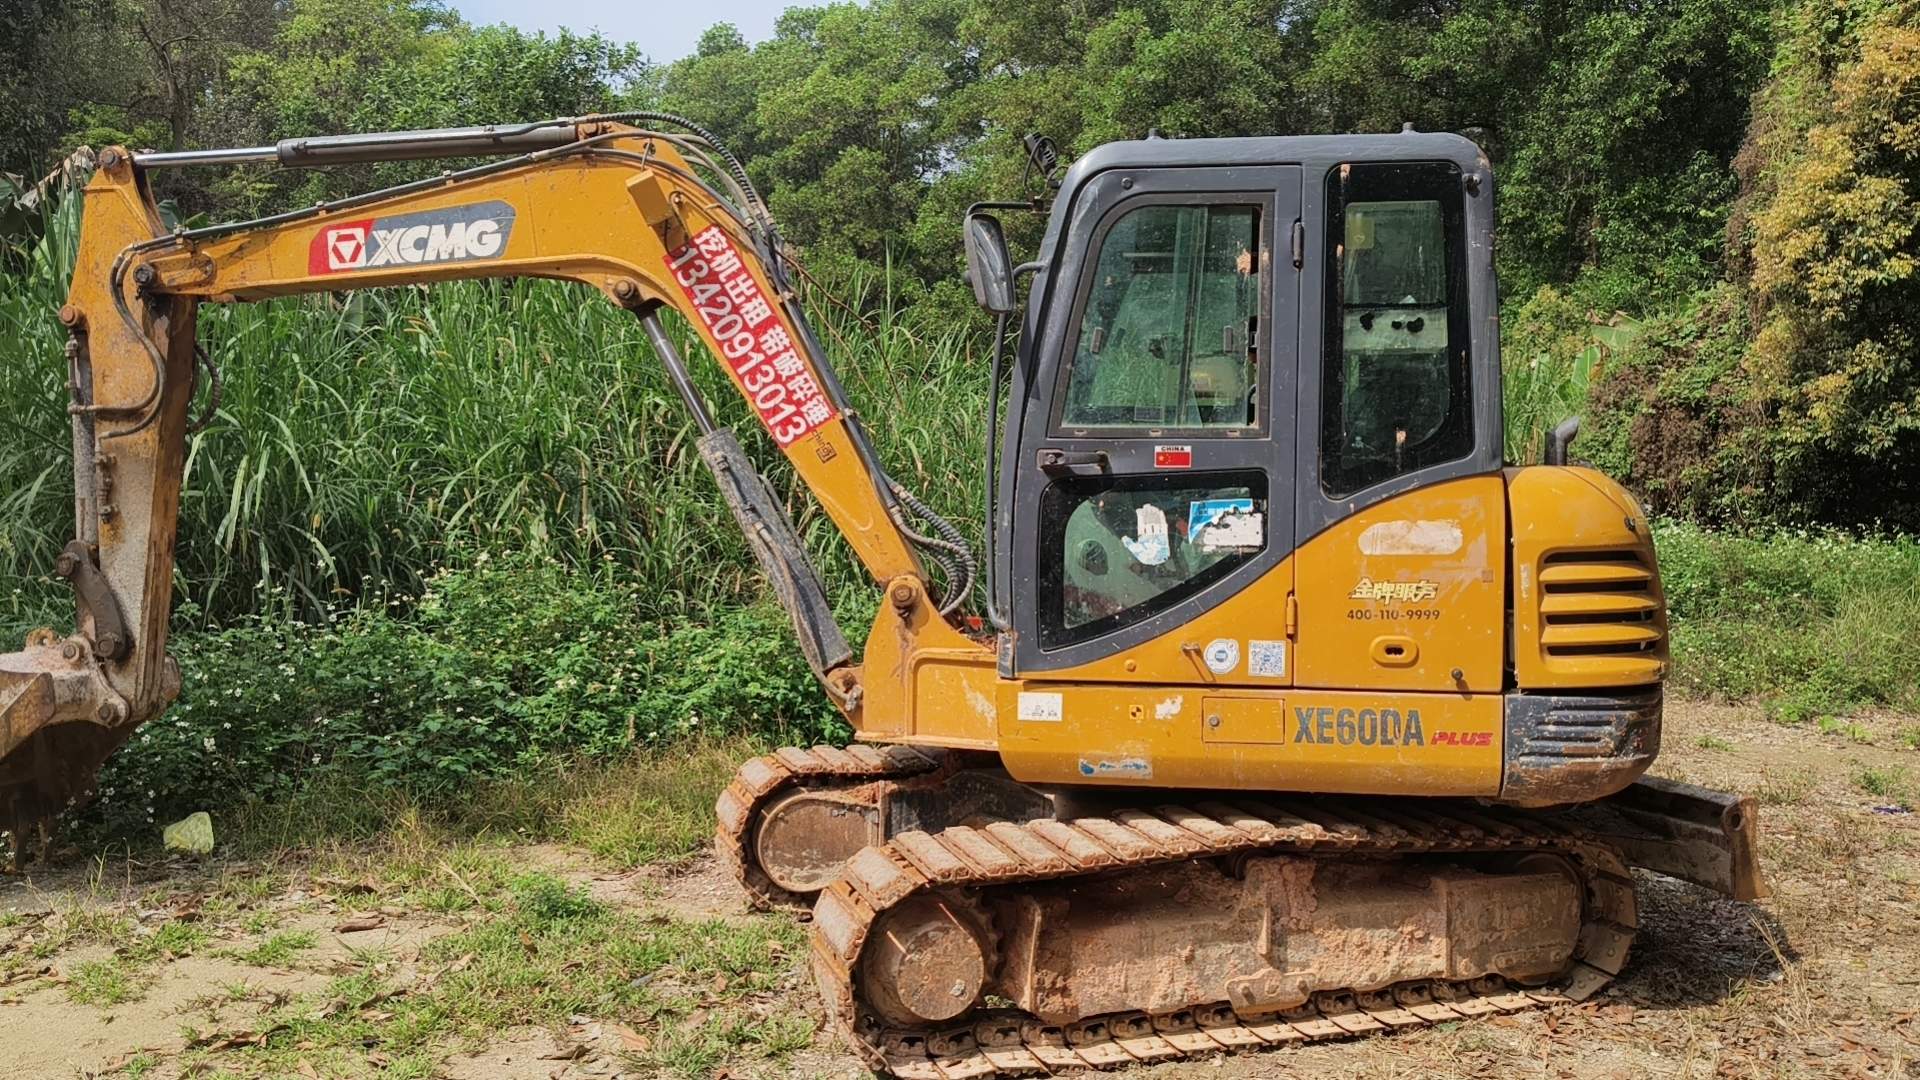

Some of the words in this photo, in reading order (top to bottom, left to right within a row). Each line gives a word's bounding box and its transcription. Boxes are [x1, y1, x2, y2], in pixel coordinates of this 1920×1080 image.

[366, 219, 502, 267] XCMG
[671, 246, 807, 444] 13420913013
[694, 226, 772, 329] 挖机出租
[759, 325, 832, 427] 带破碎锤
[1349, 577, 1439, 605] 金牌服务
[1347, 609, 1440, 620] 400-110-9999
[1294, 706, 1425, 746] XE60DA
[1430, 731, 1494, 747] PLUS
